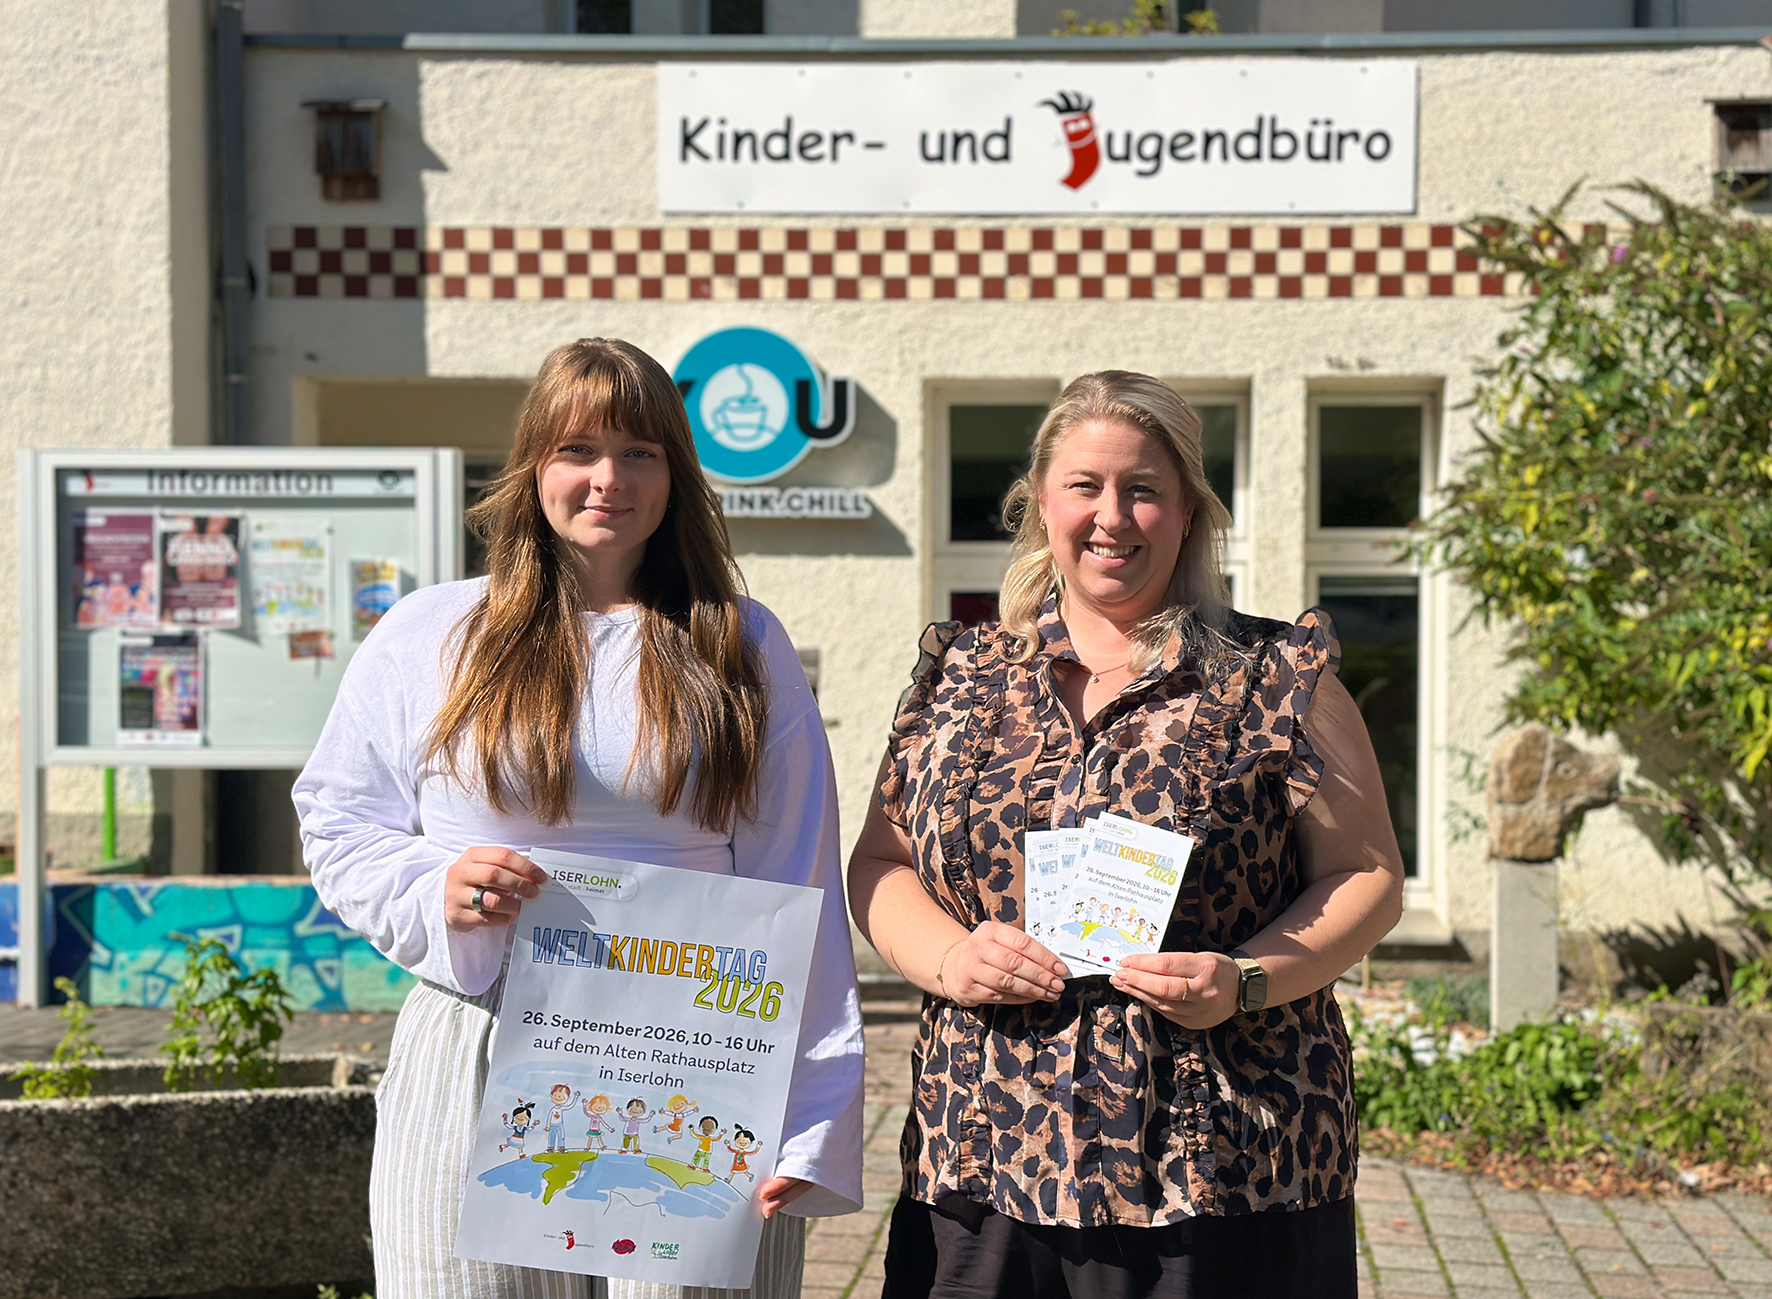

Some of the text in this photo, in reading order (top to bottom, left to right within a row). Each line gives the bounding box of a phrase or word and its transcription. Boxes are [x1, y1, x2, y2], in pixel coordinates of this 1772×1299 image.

[679, 115, 886, 163] Kinder-
[919, 117, 1013, 163] und
[1093, 837, 1175, 872] WELTKINDERTAG
[552, 869, 622, 889] ISERLOHN.
[1095, 868, 1126, 883] September
[1160, 890, 1172, 898] Uhr
[1145, 862, 1179, 887] 2026
[1098, 879, 1111, 888] dem
[1111, 883, 1127, 893] Alten
[1127, 888, 1164, 905] Rathausplatz
[1115, 893, 1138, 905] Iserlohn
[532, 926, 768, 985] WELTKINDERTAG
[693, 968, 784, 1022] 2026
[522, 1010, 548, 1027] 26.
[550, 1014, 642, 1039] September
[691, 1032, 712, 1047] 10
[725, 1035, 744, 1051] 16
[745, 1038, 775, 1055] Uhr
[533, 1036, 756, 1076] auf dem Alten Rathausplatz
[599, 1065, 685, 1089] in Iserlohn
[652, 1242, 680, 1251] KINDER
